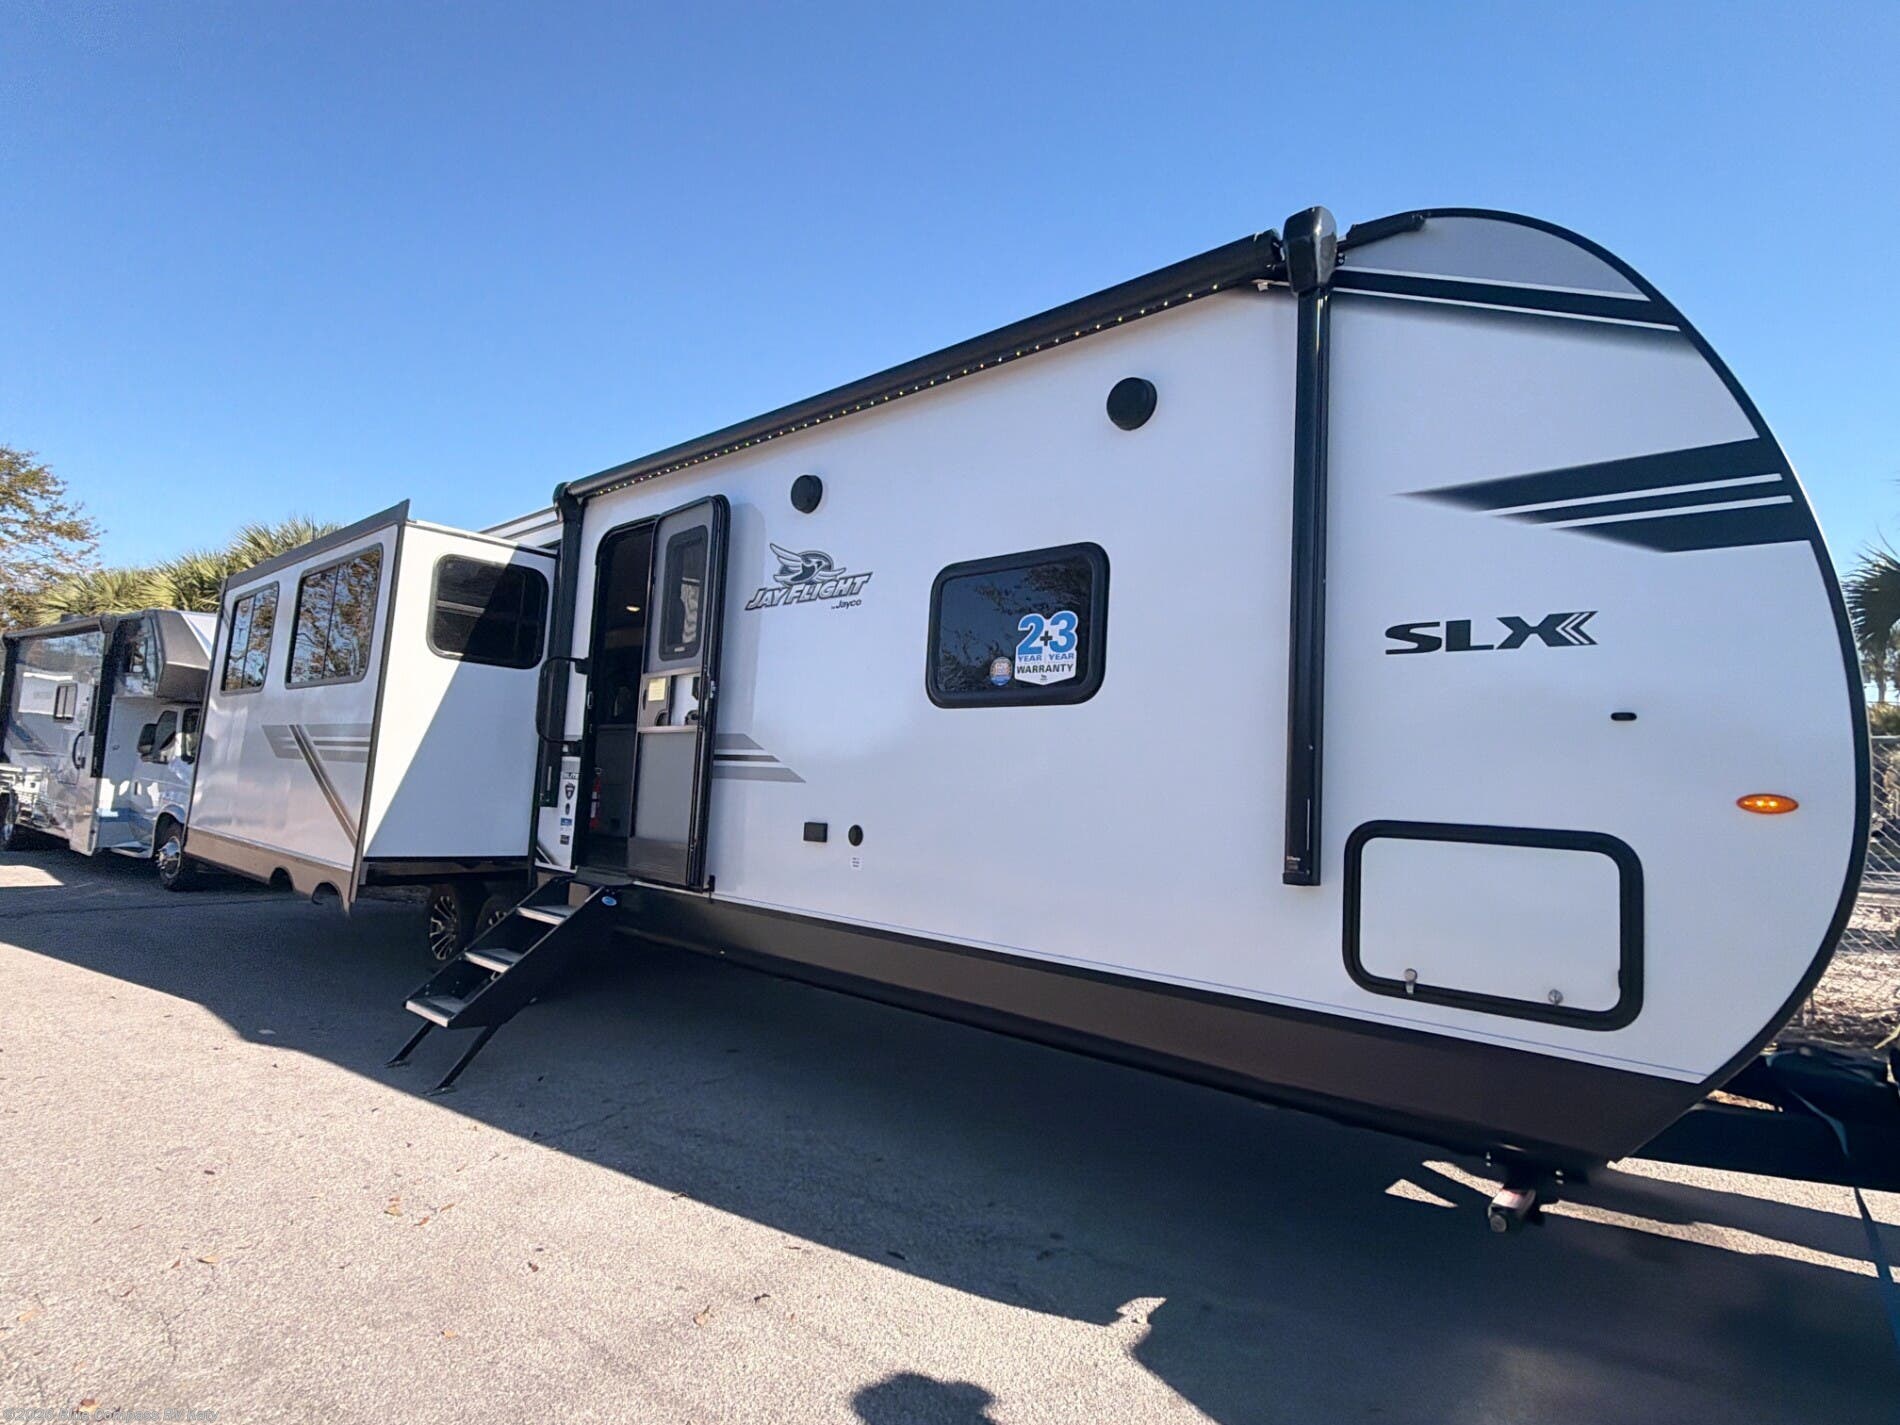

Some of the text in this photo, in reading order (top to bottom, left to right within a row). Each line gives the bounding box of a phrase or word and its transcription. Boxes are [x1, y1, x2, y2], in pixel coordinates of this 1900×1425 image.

[1385, 610, 1599, 655] SLX
[1049, 653, 1074, 661] YEAR
[1017, 664, 1074, 674] WARRANTY
